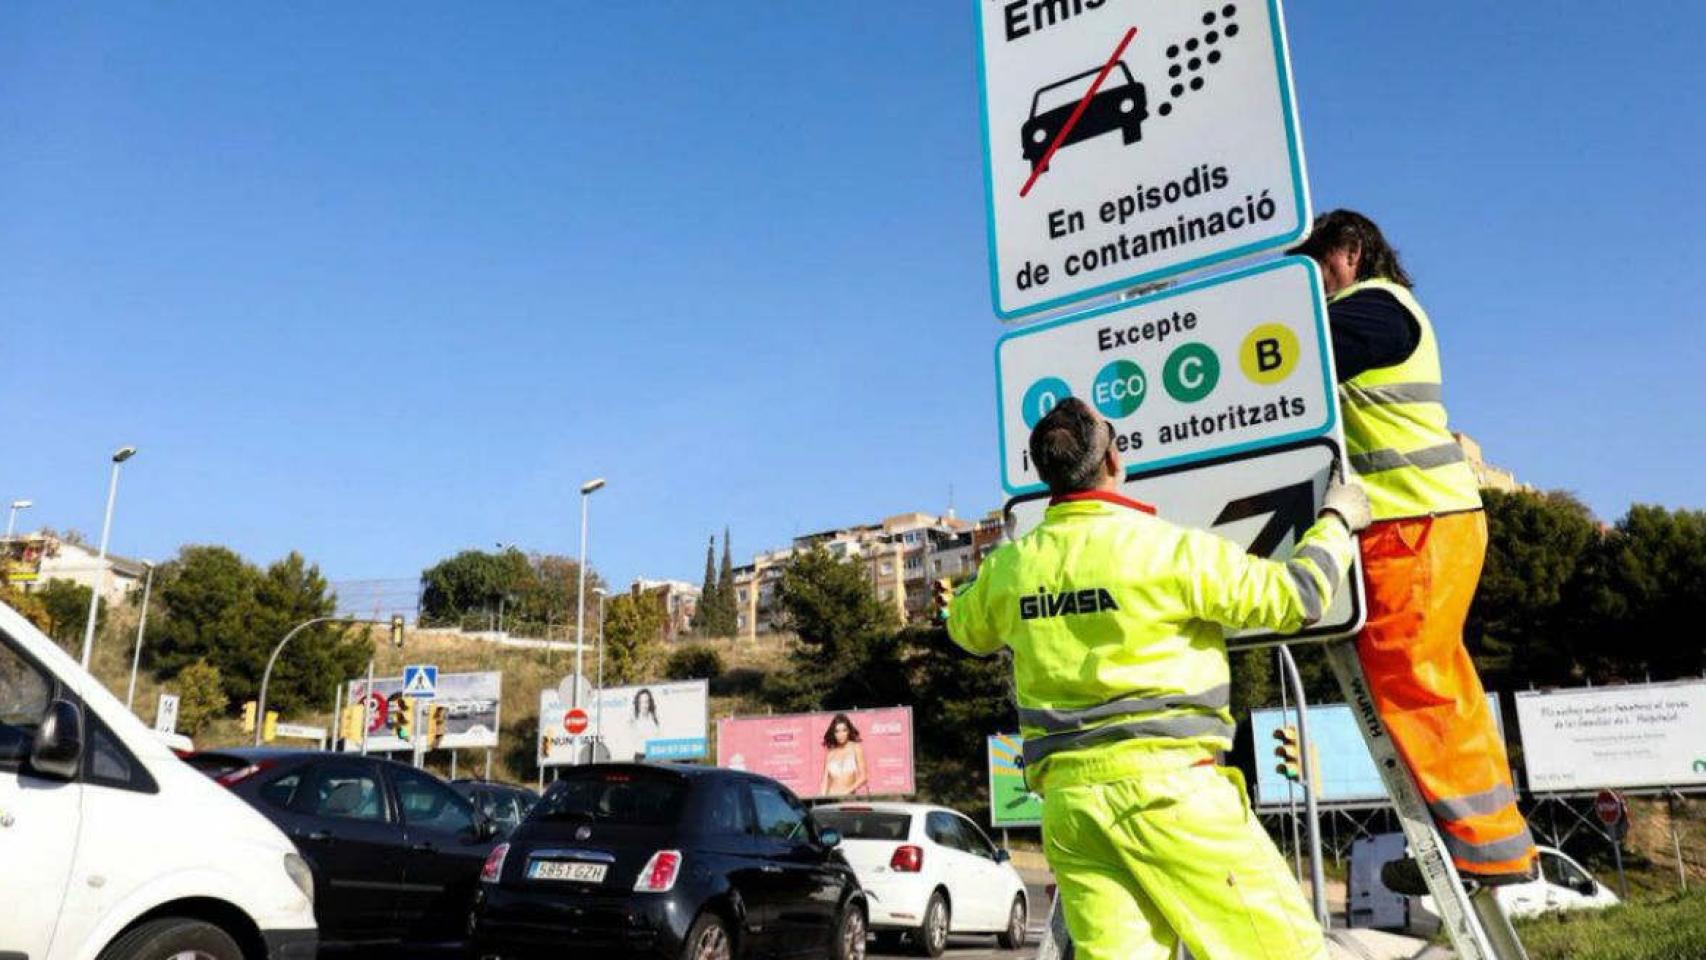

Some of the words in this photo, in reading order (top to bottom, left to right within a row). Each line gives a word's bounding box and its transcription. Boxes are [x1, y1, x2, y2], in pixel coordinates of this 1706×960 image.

[1049, 208, 1085, 239] En
[1099, 164, 1229, 225] episodis
[1016, 261, 1049, 290] de
[1064, 189, 1276, 277] contaminació
[1097, 309, 1198, 351] Excepte
[1178, 357, 1204, 389] C
[1255, 338, 1283, 373] B
[1095, 375, 1144, 405] ECO
[1022, 449, 1029, 472] i
[1159, 395, 1307, 445] autoritzats
